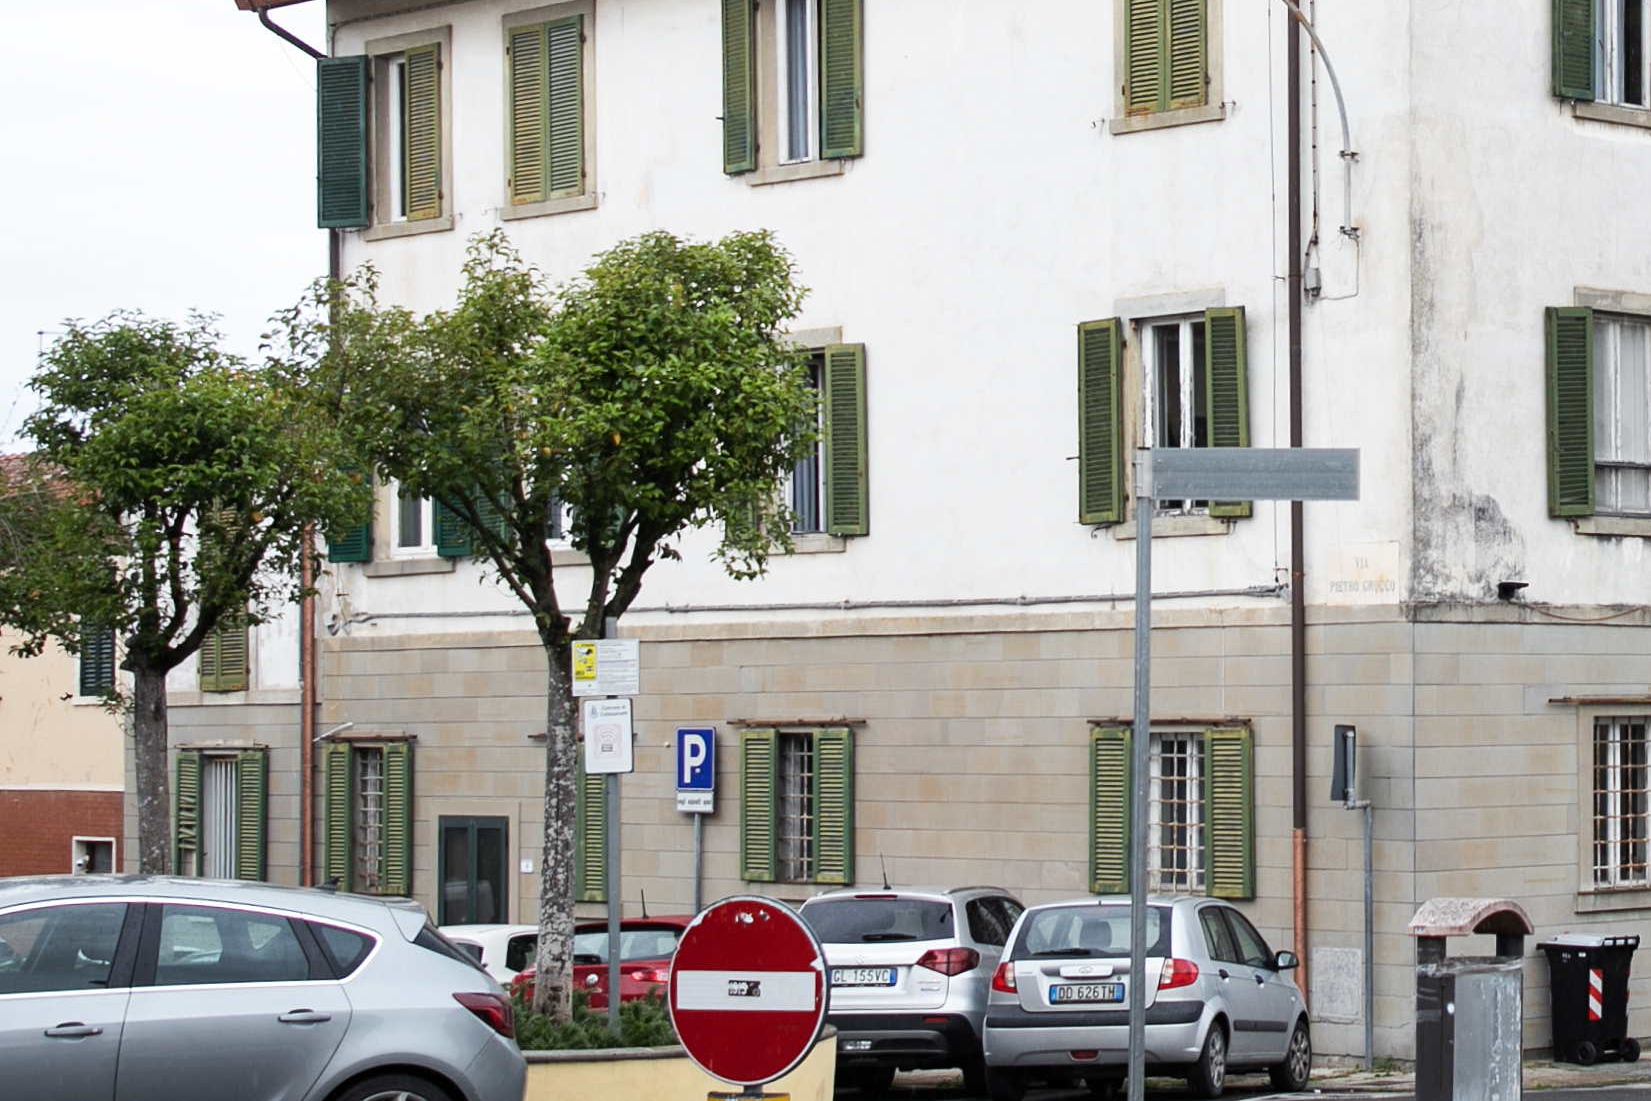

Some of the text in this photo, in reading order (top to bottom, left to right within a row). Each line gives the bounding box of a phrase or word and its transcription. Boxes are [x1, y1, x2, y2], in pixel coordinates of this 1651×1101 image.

[1355, 557, 1369, 569] VIA
[1330, 580, 1359, 593] PIETRO
[684, 733, 707, 783] P
[833, 969, 889, 982] GL 155VC
[1058, 986, 1116, 1000] DD 626TH
